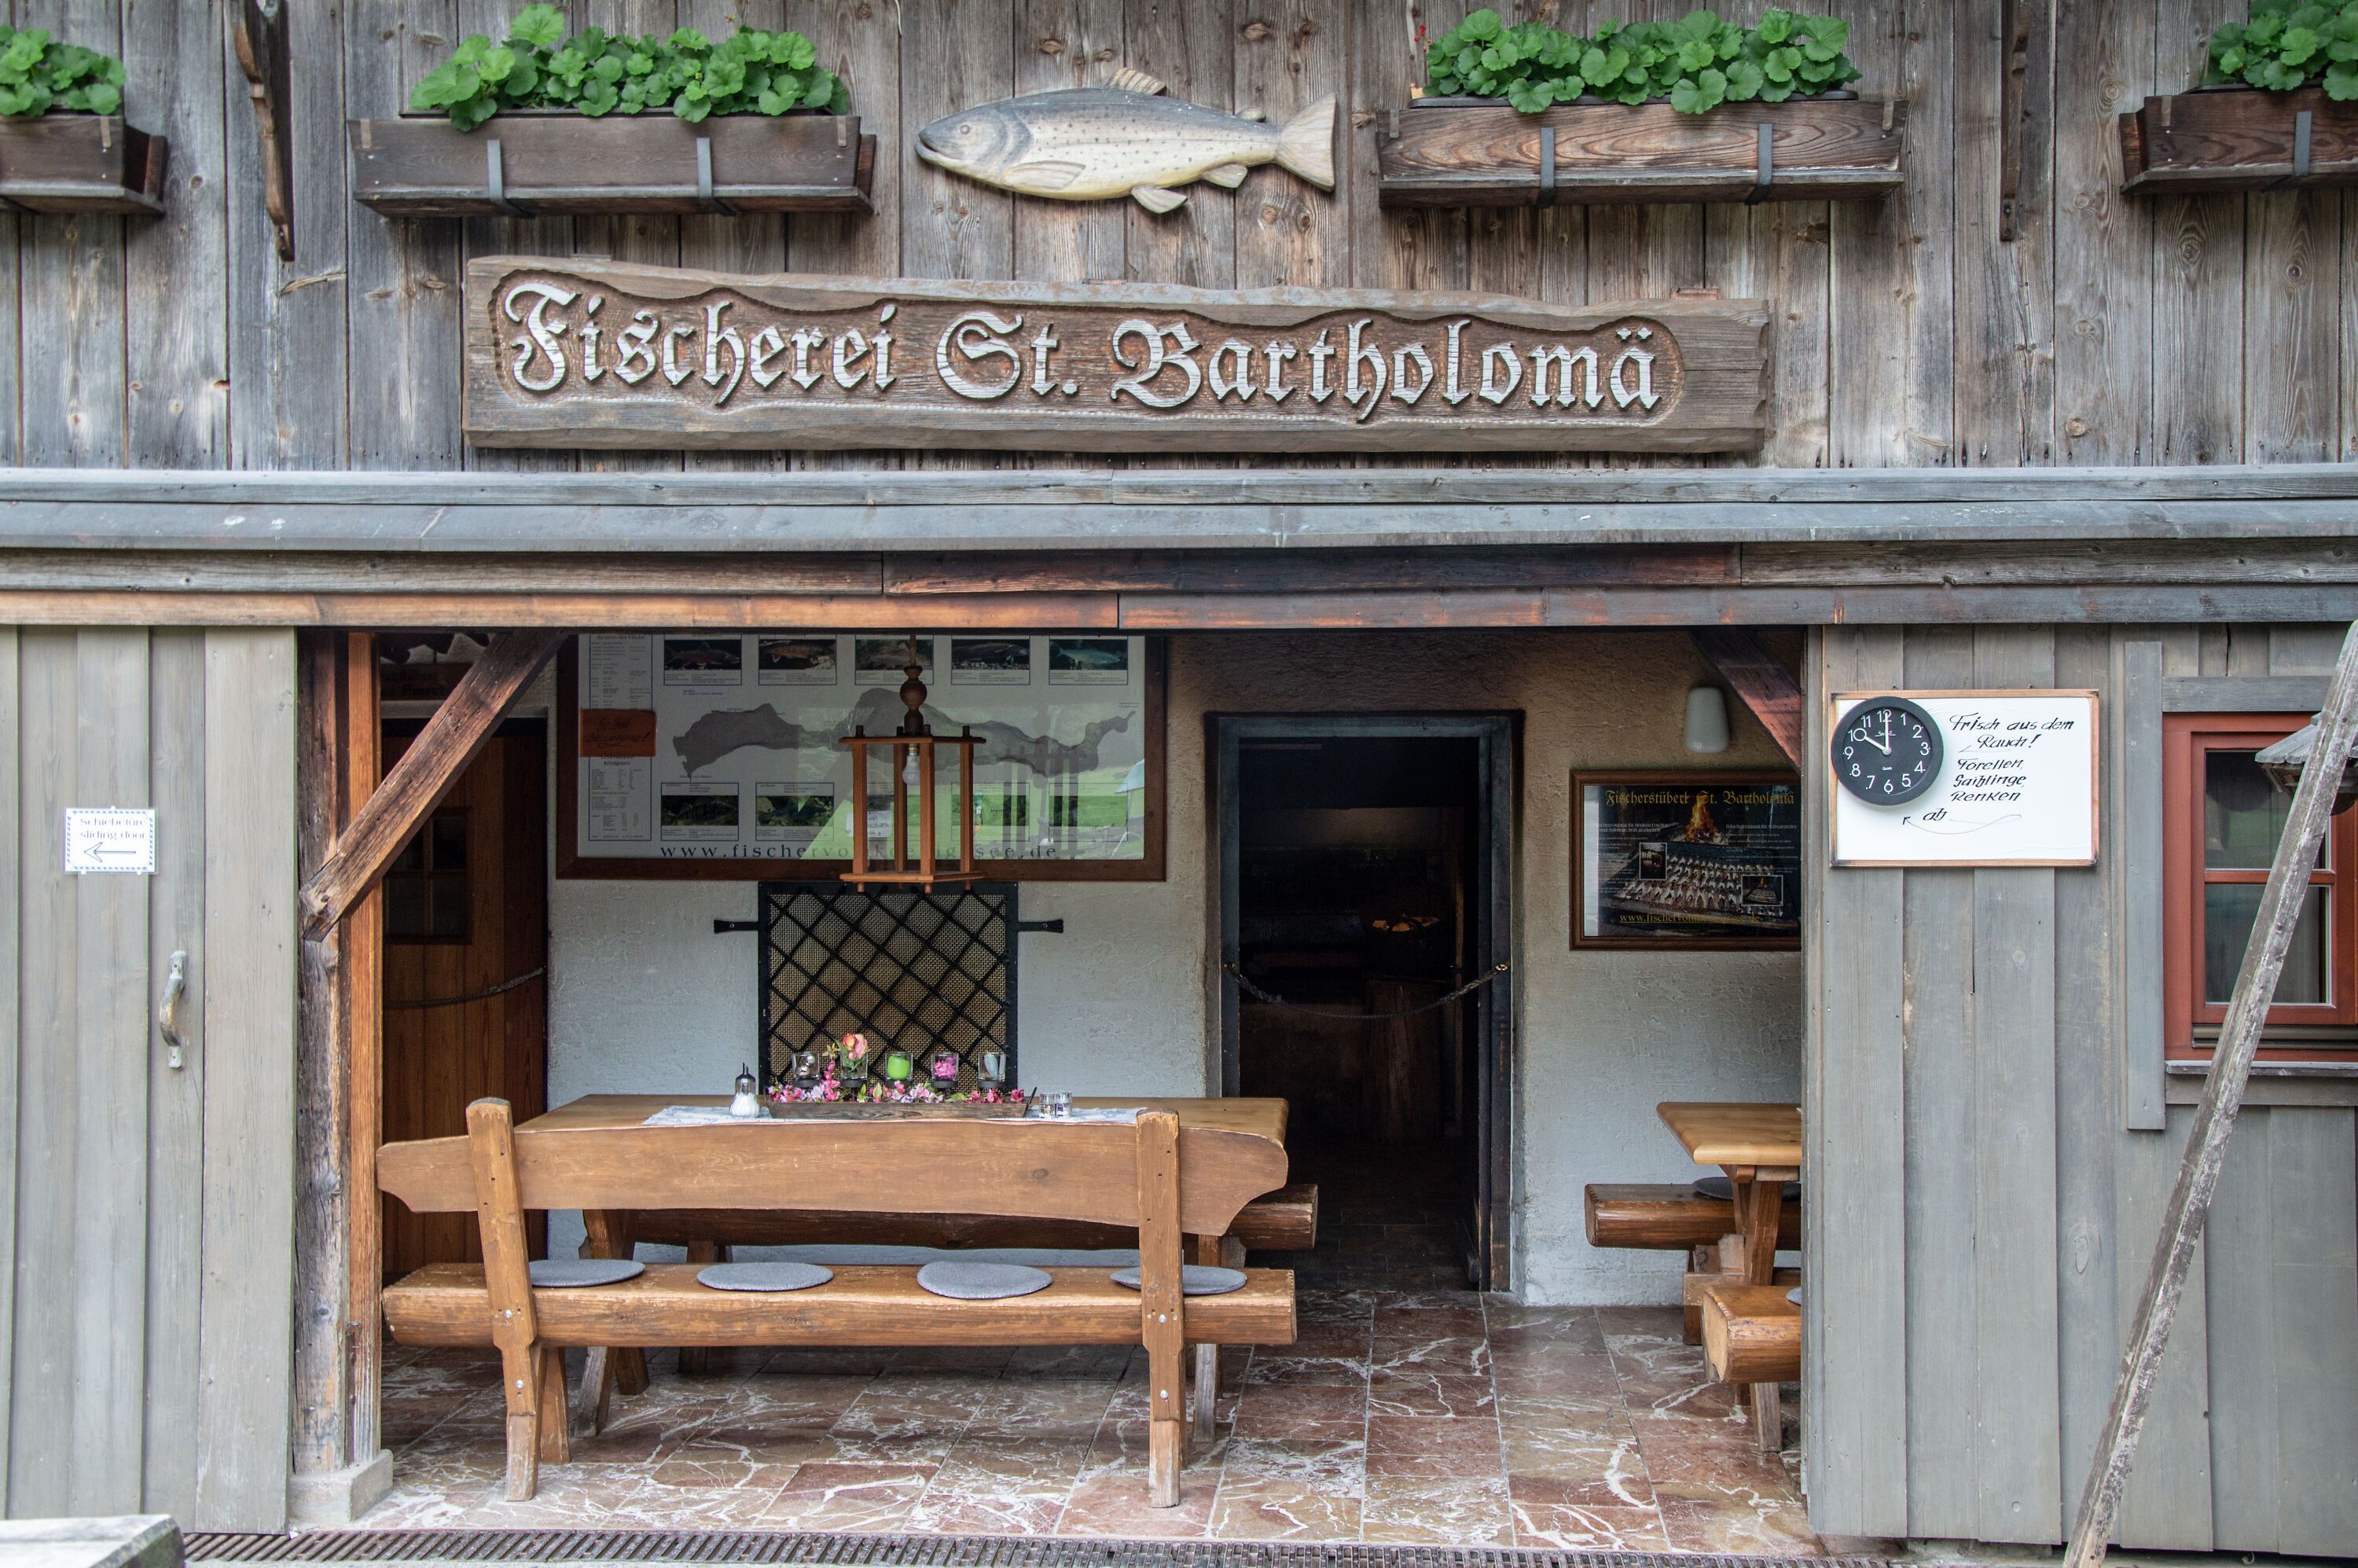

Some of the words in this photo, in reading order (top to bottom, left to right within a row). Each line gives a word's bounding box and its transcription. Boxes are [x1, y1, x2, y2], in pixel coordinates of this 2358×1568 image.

[504, 281, 896, 406] Fischerei
[936, 310, 1081, 400] St.
[1110, 318, 1662, 423] Bartholomä
[1861, 715, 1871, 728] 11
[1877, 709, 1892, 723] 12
[1901, 713, 1906, 726] 1
[1949, 713, 2000, 731] Frisch
[2007, 721, 2039, 731] aus
[2041, 717, 2075, 731] dem
[1847, 728, 1868, 742] 10
[1912, 725, 1923, 739] 2
[1977, 733, 2042, 749] Rauch!
[1844, 747, 1853, 760] 9
[1920, 742, 1930, 755] 3
[1851, 763, 1861, 777] 8
[1914, 761, 1925, 773] 4
[1868, 775, 1875, 789] 7
[1883, 779, 1893, 793] 6
[1901, 773, 1912, 788] 5
[1951, 791, 2022, 802] Renken
